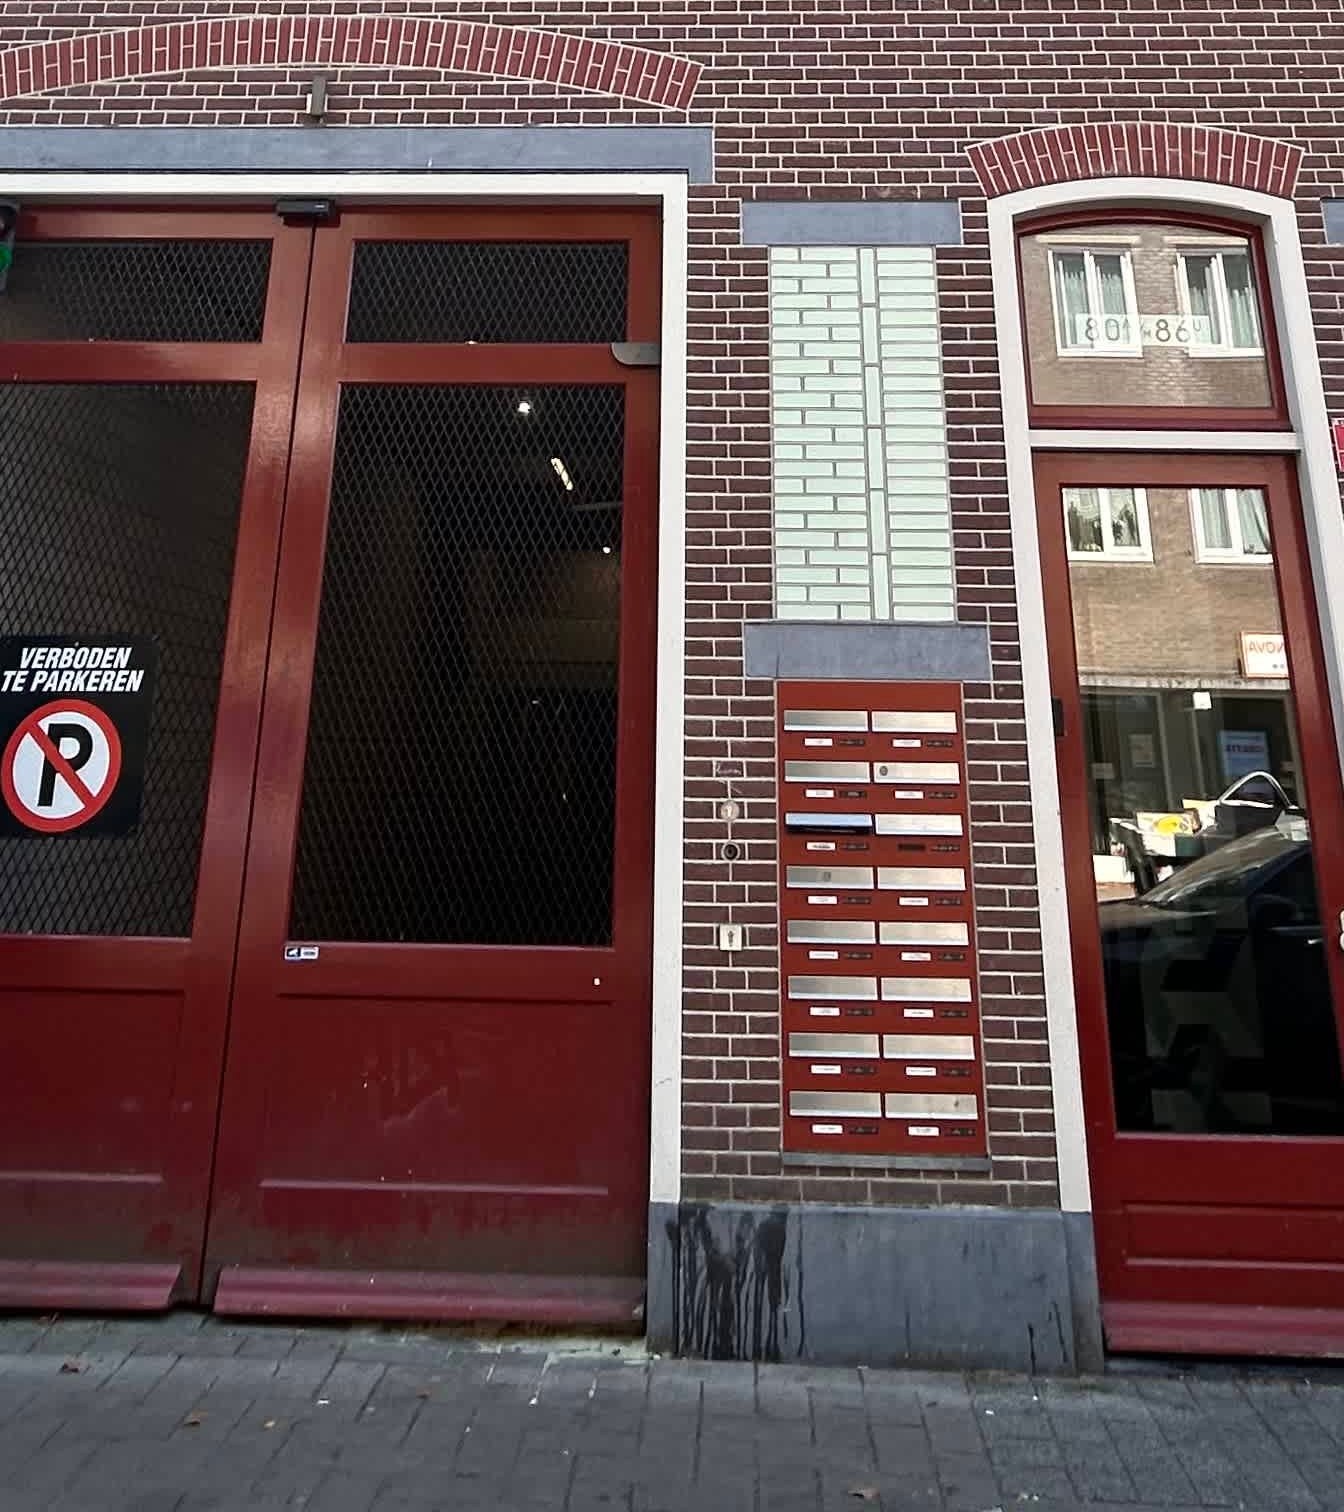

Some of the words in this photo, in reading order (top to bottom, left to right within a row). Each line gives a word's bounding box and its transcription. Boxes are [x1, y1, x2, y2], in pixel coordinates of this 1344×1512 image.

[20, 647, 133, 669] VERBODEN
[1, 671, 29, 692] TE
[30, 670, 145, 692] PARKEREN
